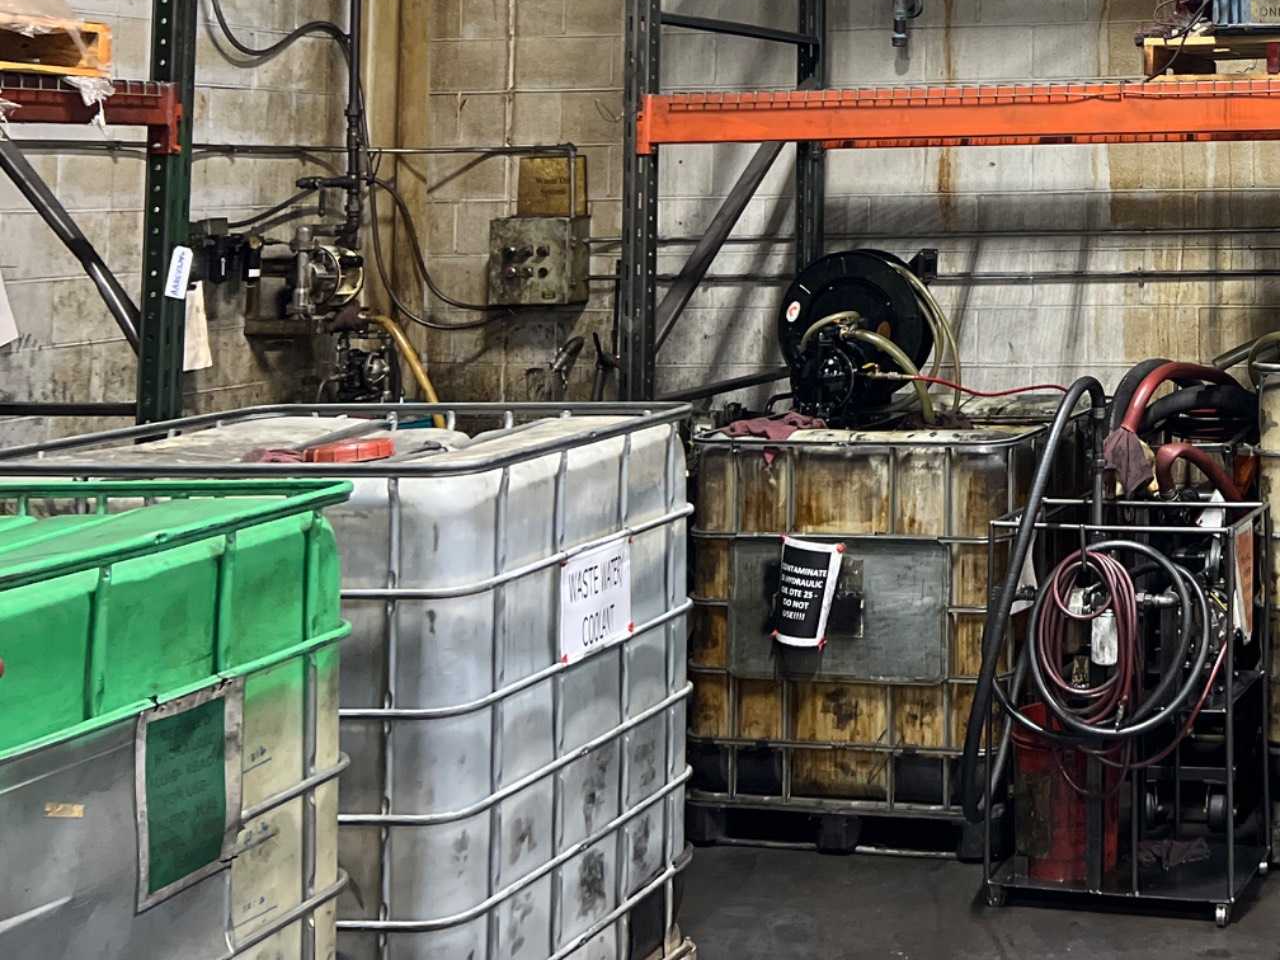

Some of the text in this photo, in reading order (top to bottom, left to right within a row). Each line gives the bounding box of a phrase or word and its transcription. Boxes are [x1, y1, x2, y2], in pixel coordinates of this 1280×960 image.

[568, 565, 599, 602] WASTE
[803, 590, 813, 599] 25
[783, 597, 810, 610] DO NOT
